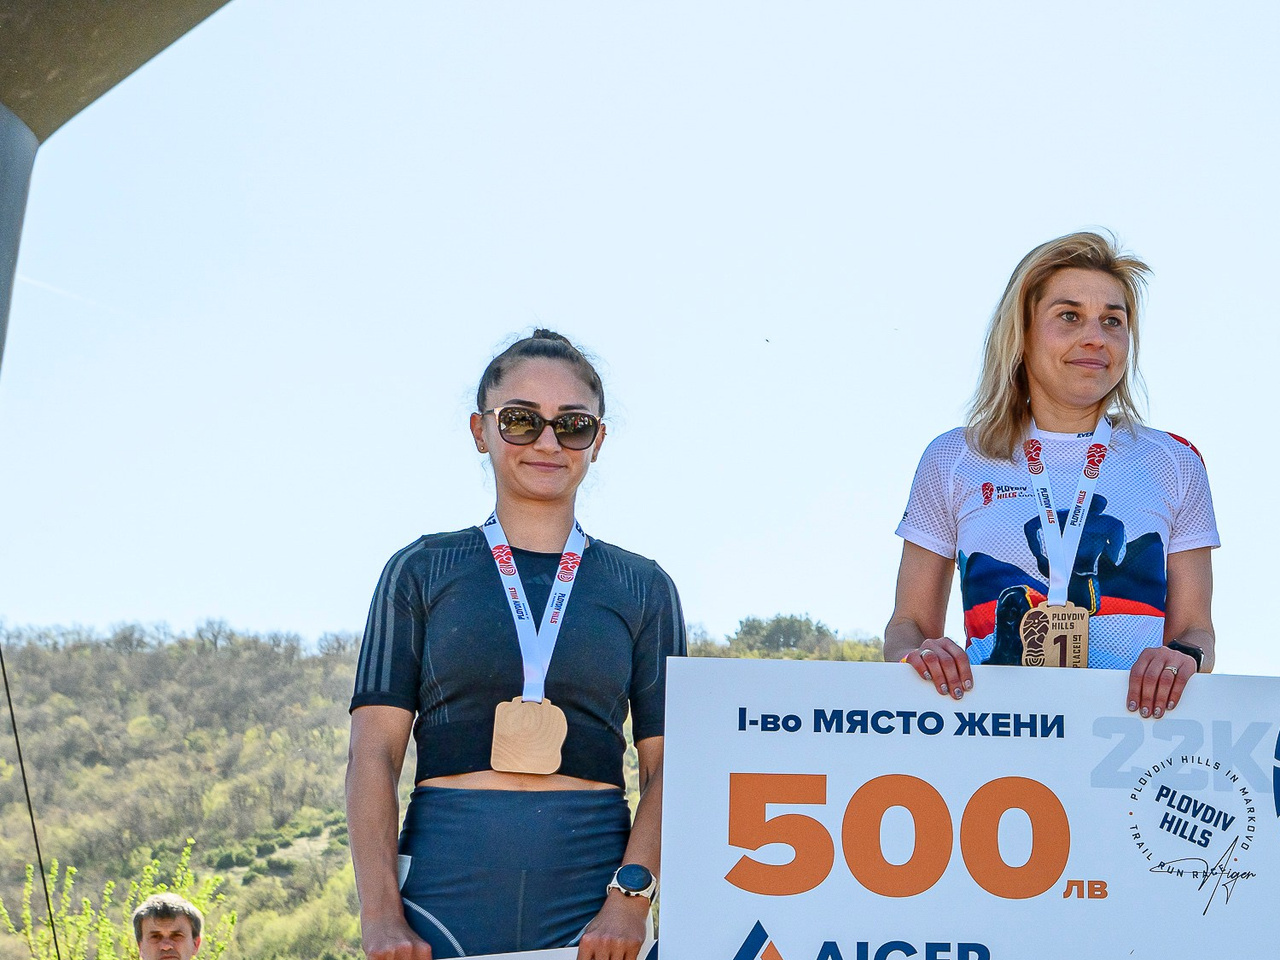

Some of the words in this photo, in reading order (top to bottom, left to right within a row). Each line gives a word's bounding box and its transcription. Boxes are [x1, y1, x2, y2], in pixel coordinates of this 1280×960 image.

[1052, 622, 1074, 630] HILLS
[813, 709, 945, 736] МЯСТО
[953, 711, 1065, 738] ЖЕНИ
[1131, 758, 1173, 800] PLOVDIV
[1182, 756, 1221, 770] HILLS
[1226, 770, 1238, 783] IN
[1240, 787, 1255, 850] MARKOVO
[1155, 785, 1235, 832] PLOVDIV
[724, 772, 1071, 900] 500
[1062, 880, 1109, 900] лв
[1130, 825, 1153, 860] TRAIL
[1158, 861, 1184, 877] RUN
[1159, 812, 1213, 848] HILLS
